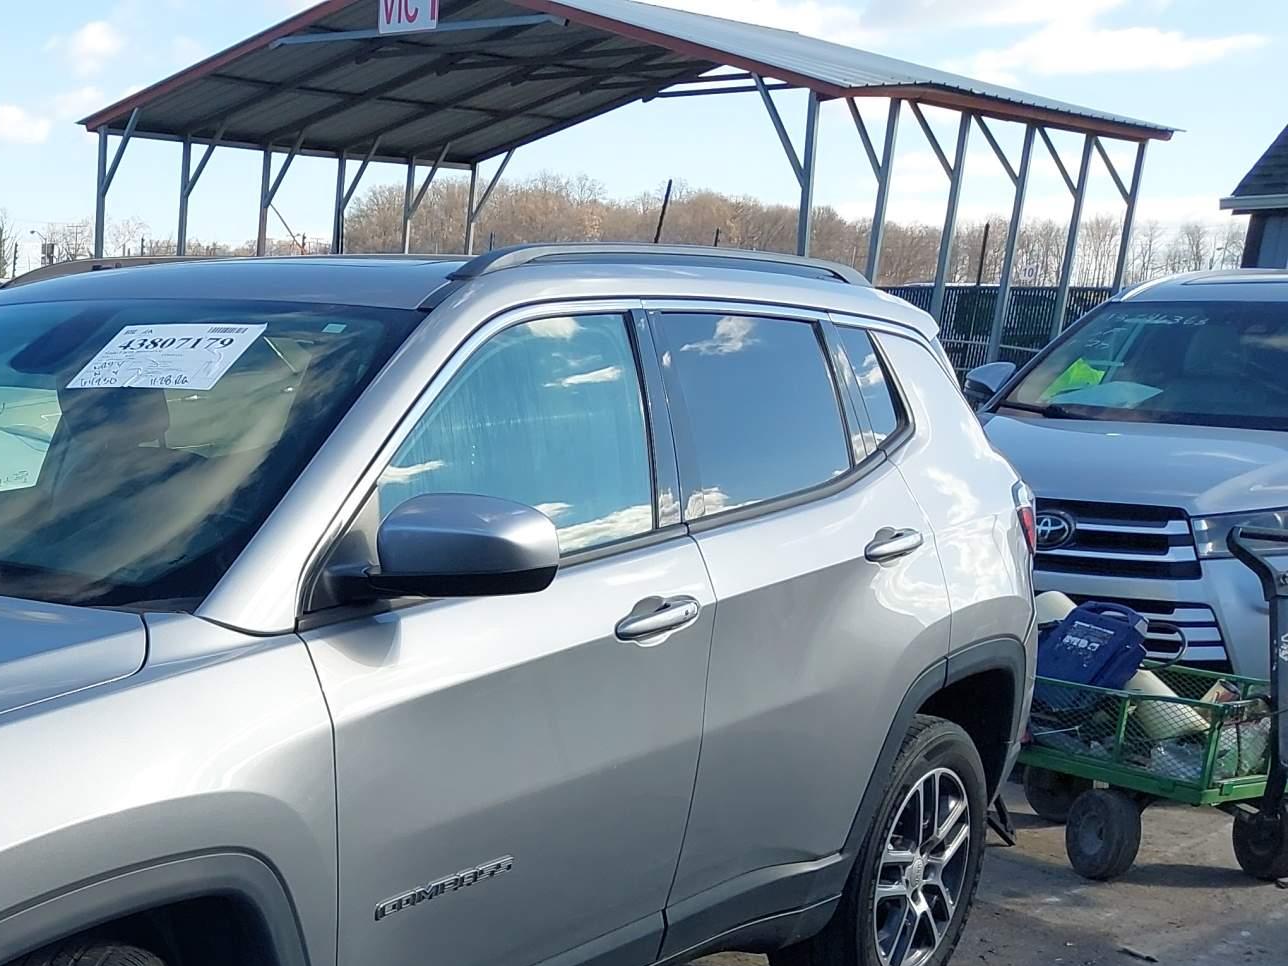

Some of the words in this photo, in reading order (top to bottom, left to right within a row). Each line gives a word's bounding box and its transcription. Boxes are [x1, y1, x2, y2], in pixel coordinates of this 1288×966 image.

[1022, 267, 1034, 278] 10
[117, 337, 235, 351] 43807179
[374, 854, 515, 922] COMPASS
